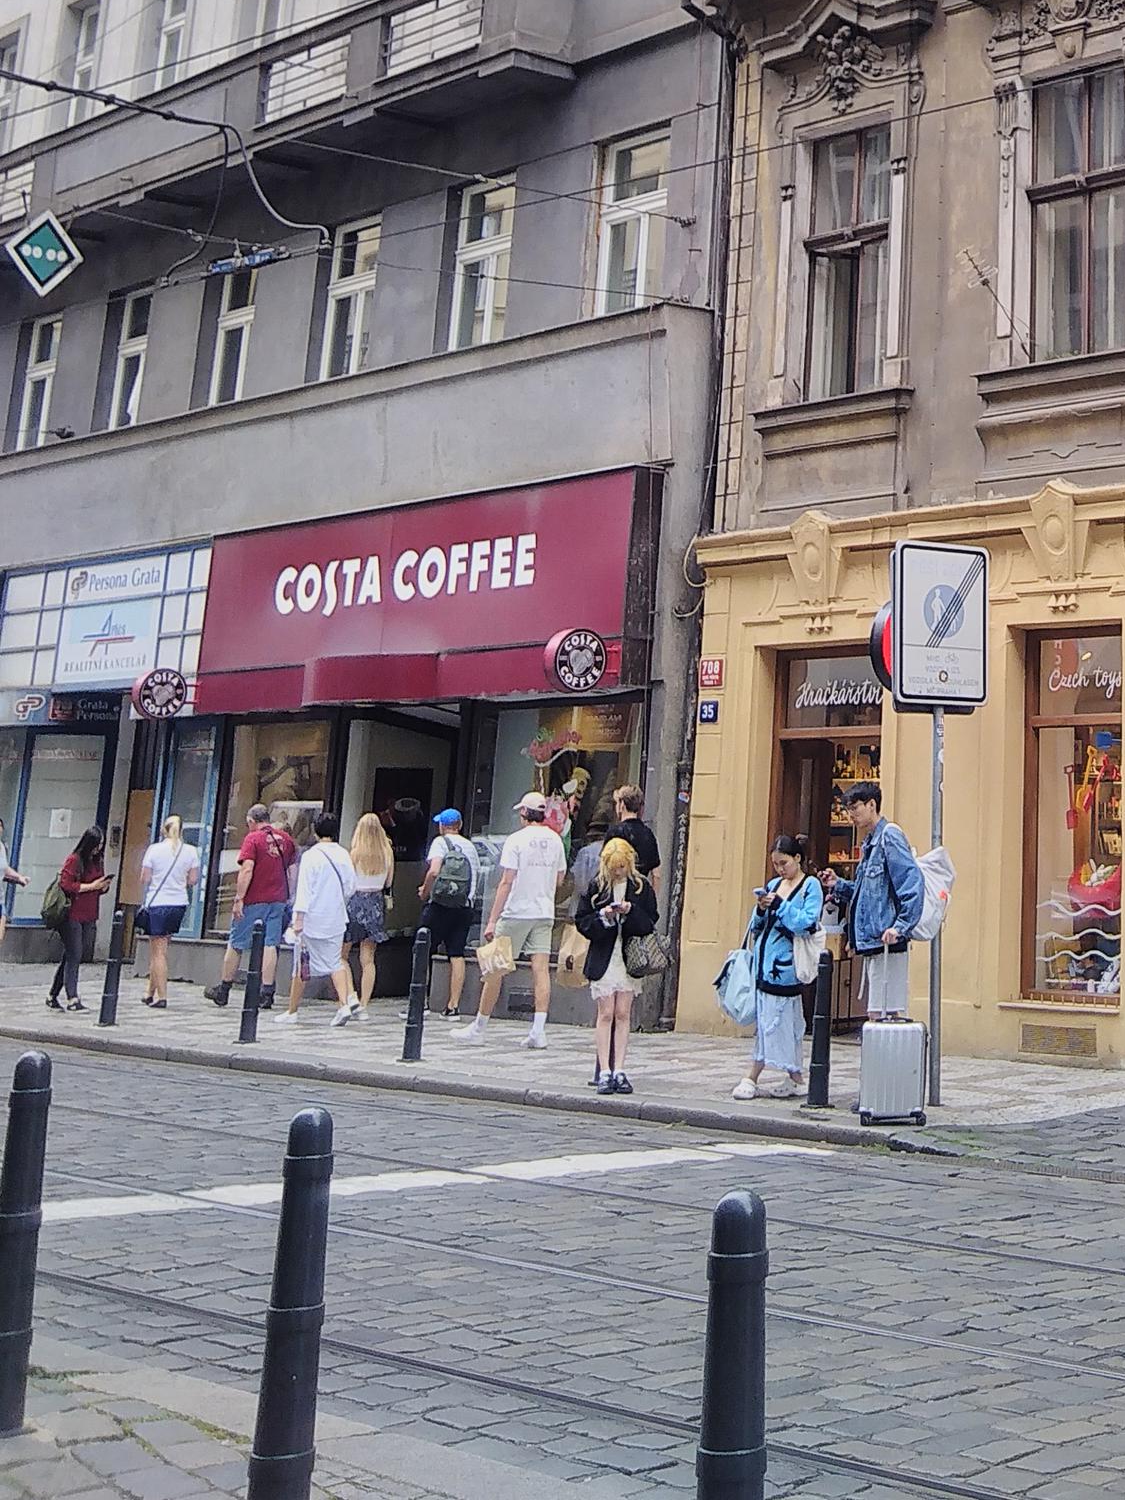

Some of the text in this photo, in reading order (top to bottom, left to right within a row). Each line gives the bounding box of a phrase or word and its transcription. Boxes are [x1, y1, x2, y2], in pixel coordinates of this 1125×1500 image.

[88, 567, 161, 592] Persona Grata
[274, 533, 537, 617] COSTA COFFEE
[564, 634, 599, 652] COSTA
[560, 666, 601, 687] COFFEE
[702, 661, 720, 675] 708
[147, 672, 180, 687] COSTA
[1048, 666, 1122, 699] Czech toys
[144, 698, 182, 716] COFFEE
[702, 704, 714, 719] 35
